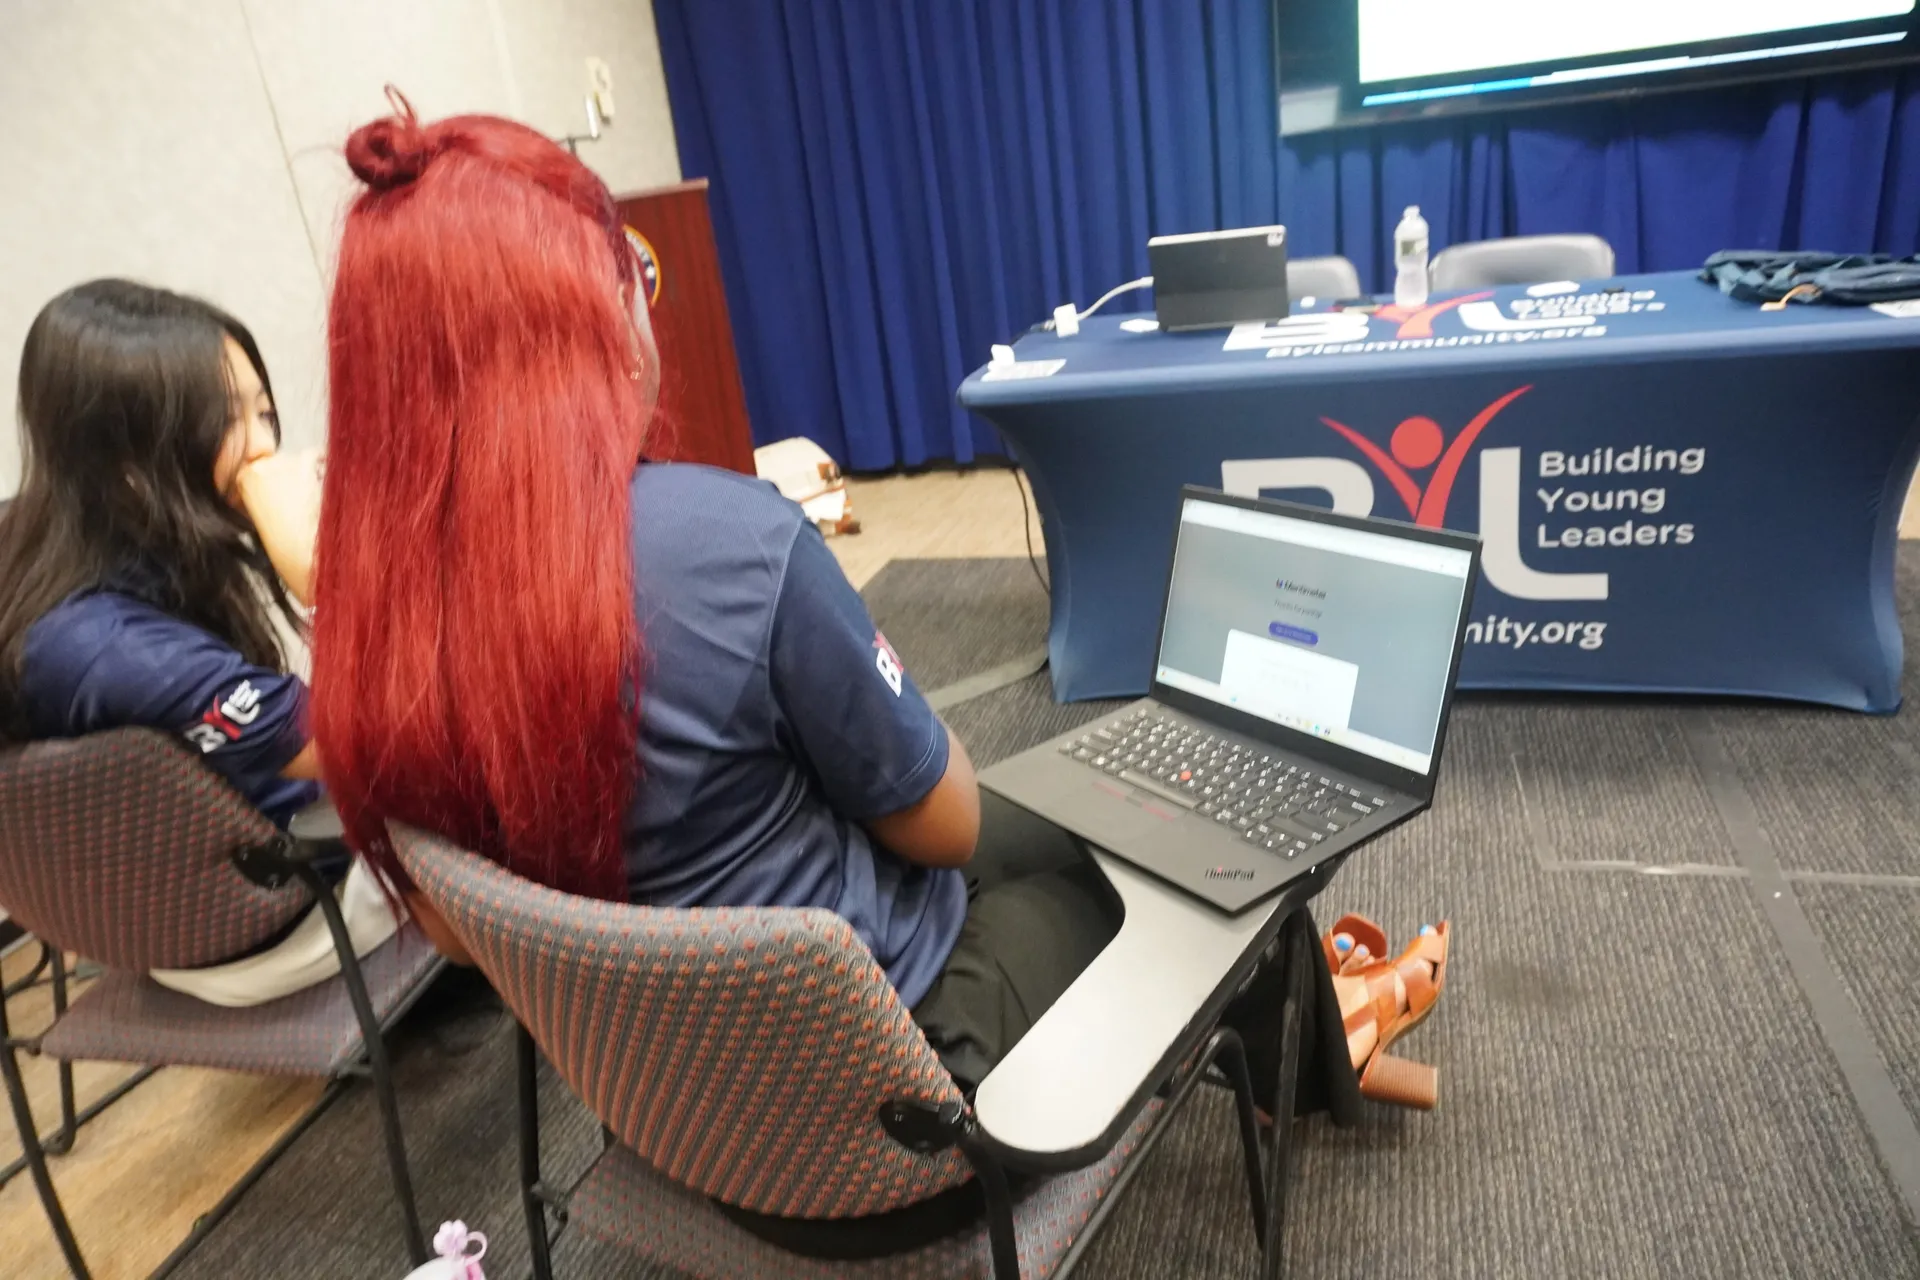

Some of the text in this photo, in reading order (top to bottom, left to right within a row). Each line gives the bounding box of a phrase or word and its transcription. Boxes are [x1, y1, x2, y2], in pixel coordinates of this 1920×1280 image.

[1539, 445, 1706, 477] Building
[1536, 487, 1666, 514] Young
[1537, 519, 1695, 548] Leaders
[1464, 615, 1608, 650] nity.org
